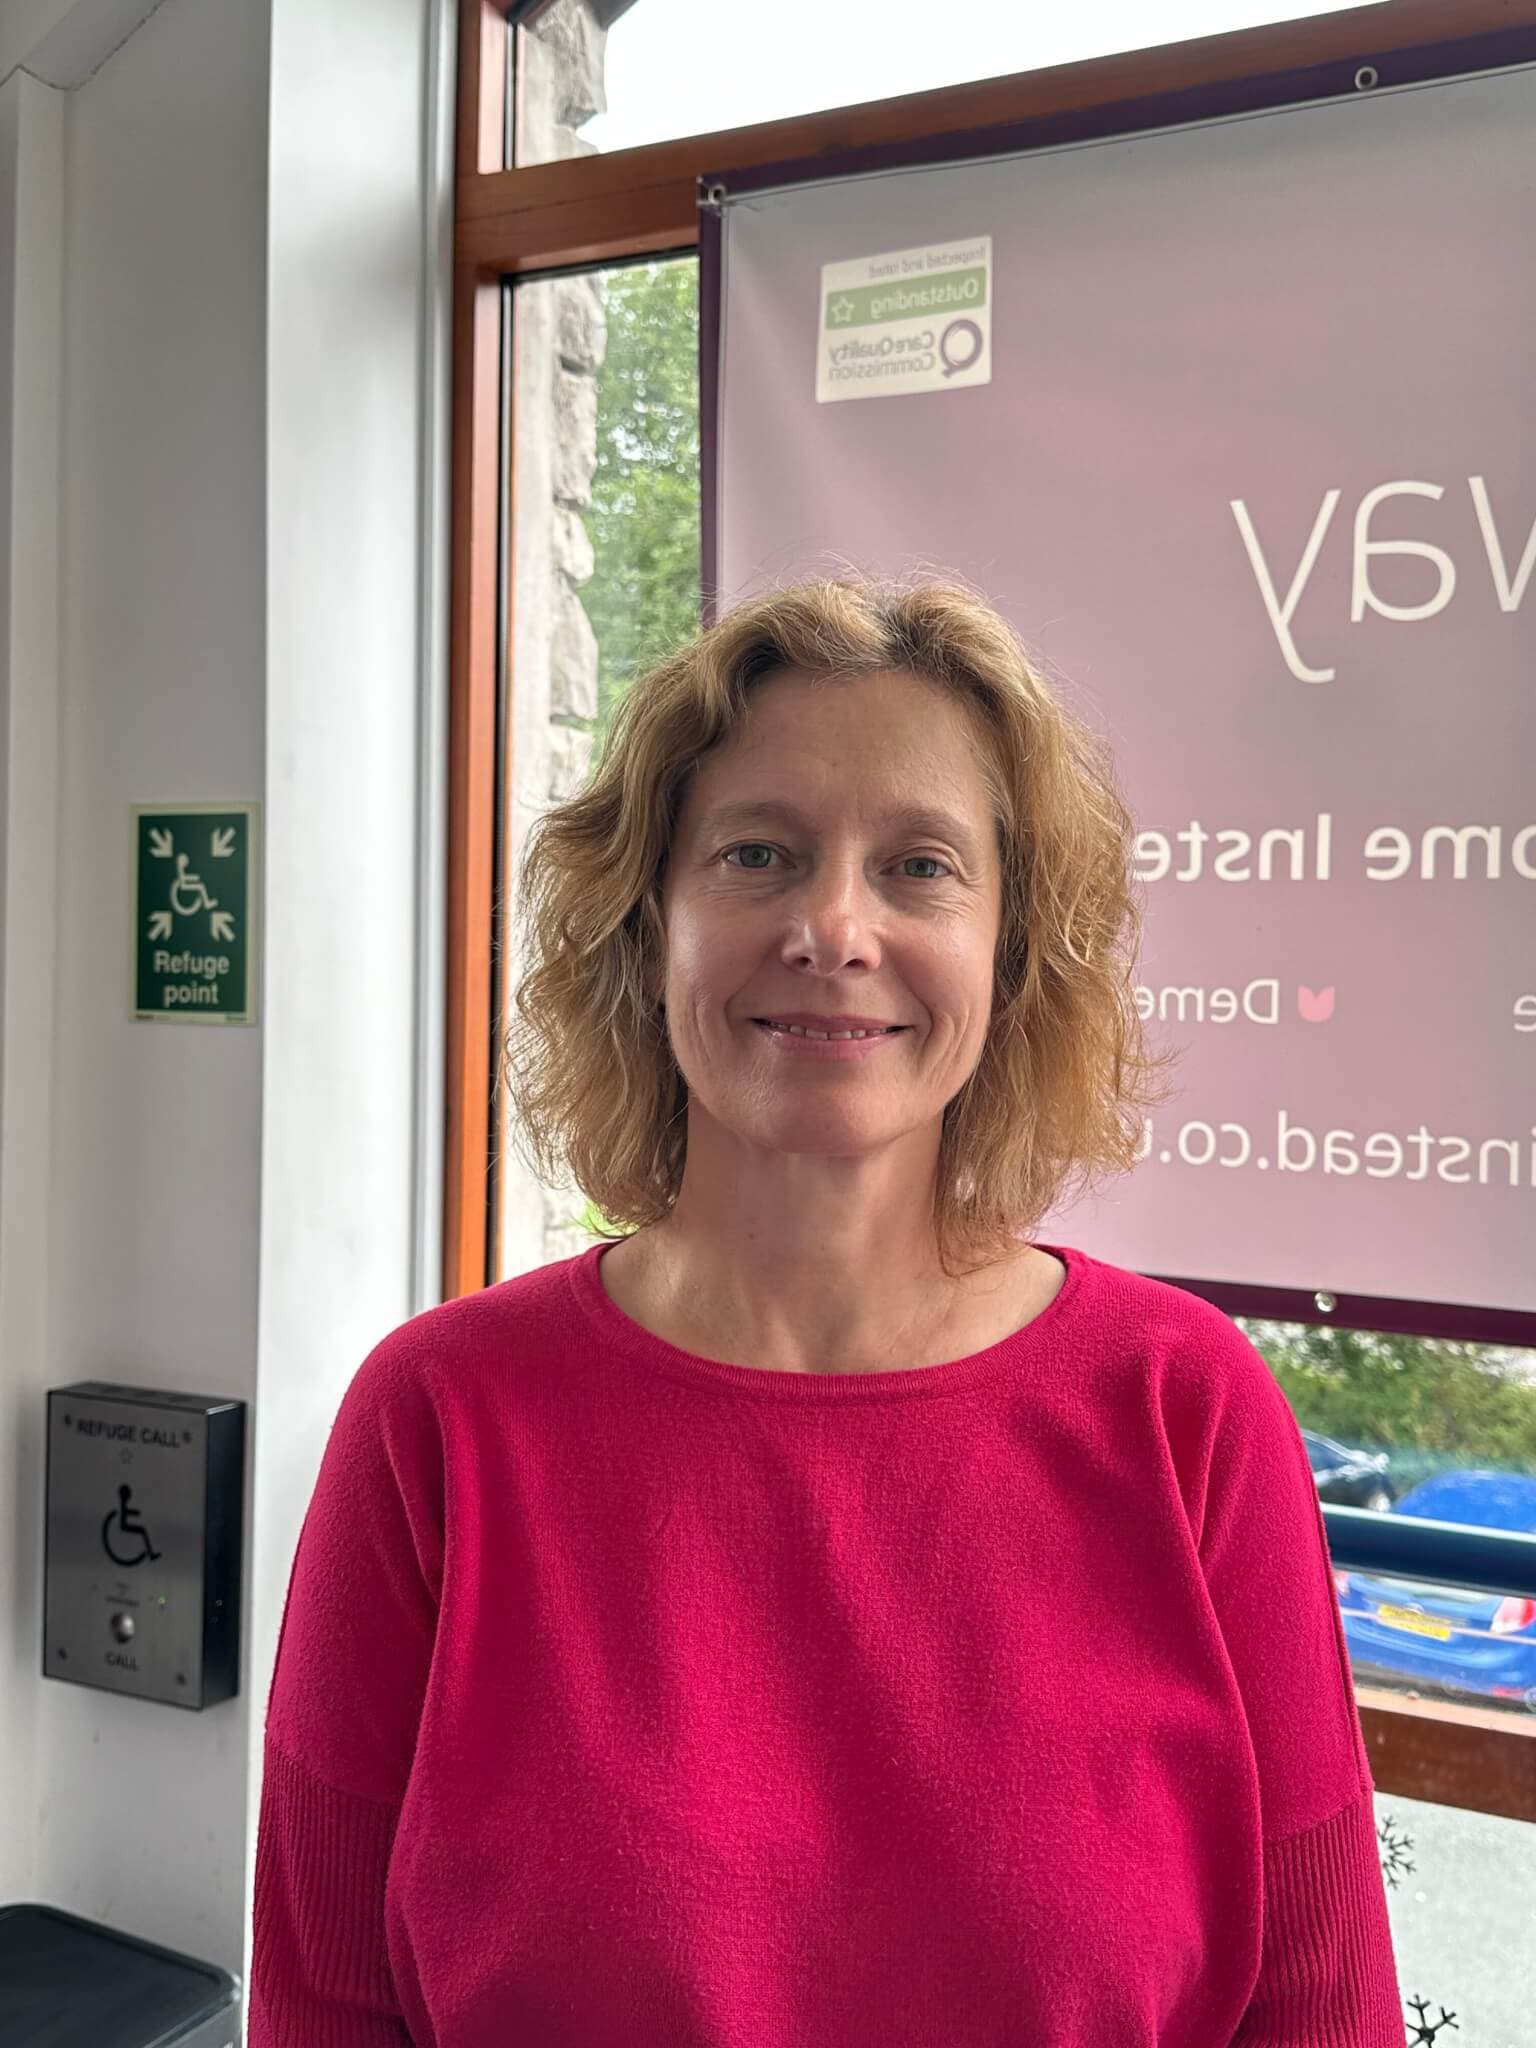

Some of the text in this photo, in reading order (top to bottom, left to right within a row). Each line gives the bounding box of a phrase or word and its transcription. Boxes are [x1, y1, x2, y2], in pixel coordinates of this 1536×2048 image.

[154, 951, 230, 980] Refuge
[164, 981, 219, 1008] point
[78, 1419, 180, 1449] REFUGE CALL
[105, 1651, 140, 1671] CALL
